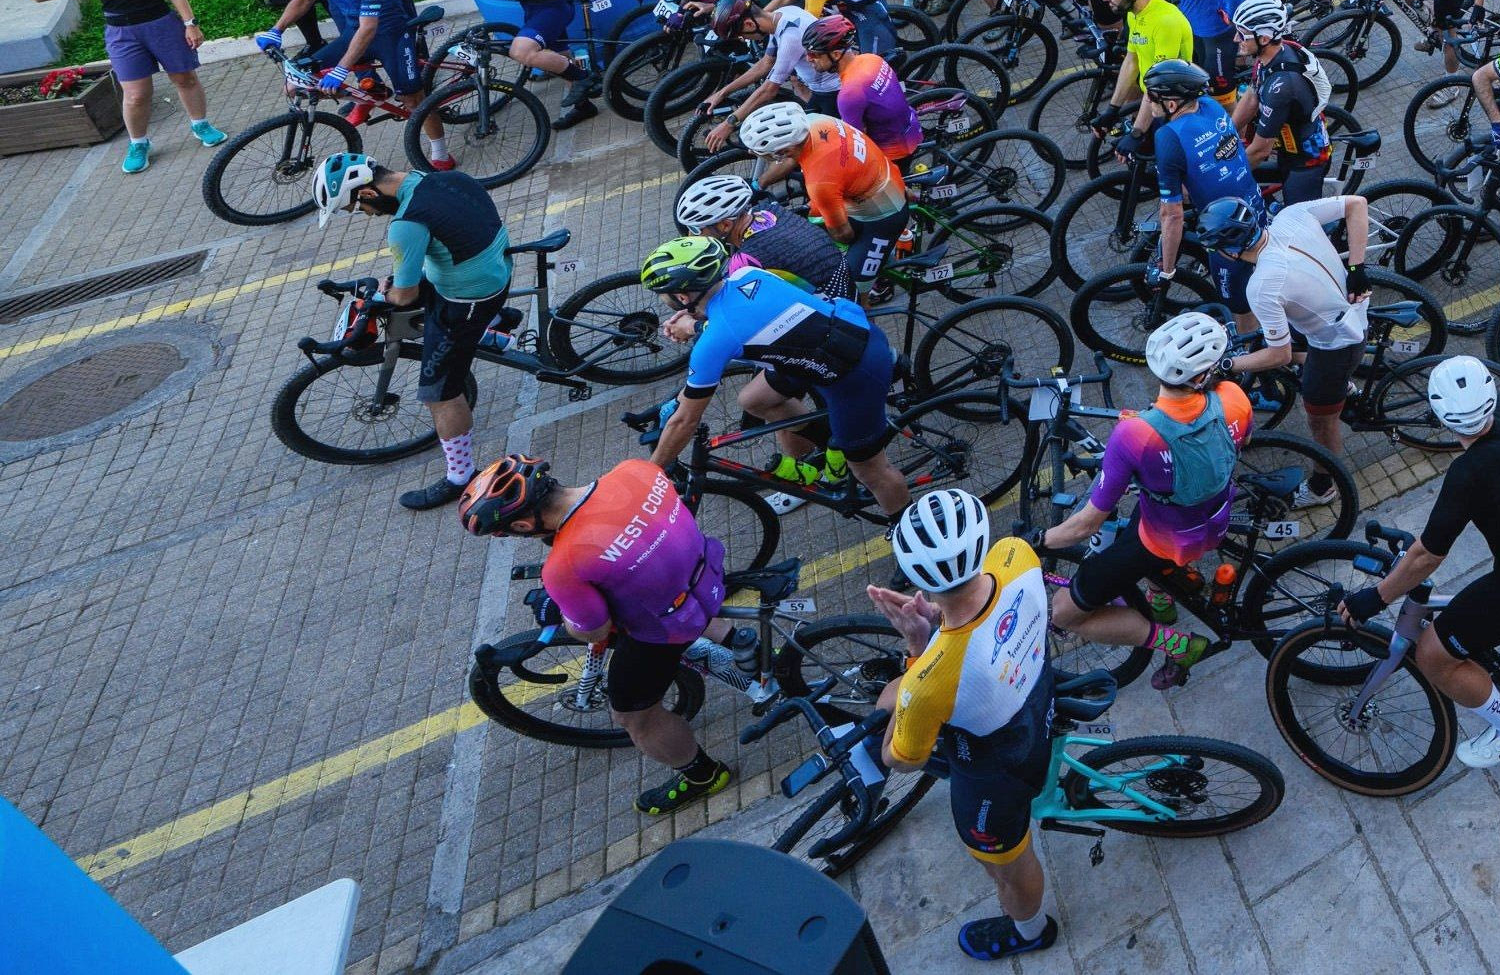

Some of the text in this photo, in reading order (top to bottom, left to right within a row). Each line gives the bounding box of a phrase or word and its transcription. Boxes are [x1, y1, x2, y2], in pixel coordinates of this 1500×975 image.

[1360, 161, 1370, 169] 20
[937, 189, 953, 197] 110
[861, 238, 889, 276] BH
[563, 263, 576, 272] 69
[932, 270, 949, 279] 127
[1401, 343, 1412, 352] 14
[760, 354, 838, 379] www.potripolis.gr
[599, 471, 669, 562] WEST COAST
[1275, 523, 1292, 536] 45
[790, 602, 804, 611] 59
[1088, 726, 1111, 734] 160
